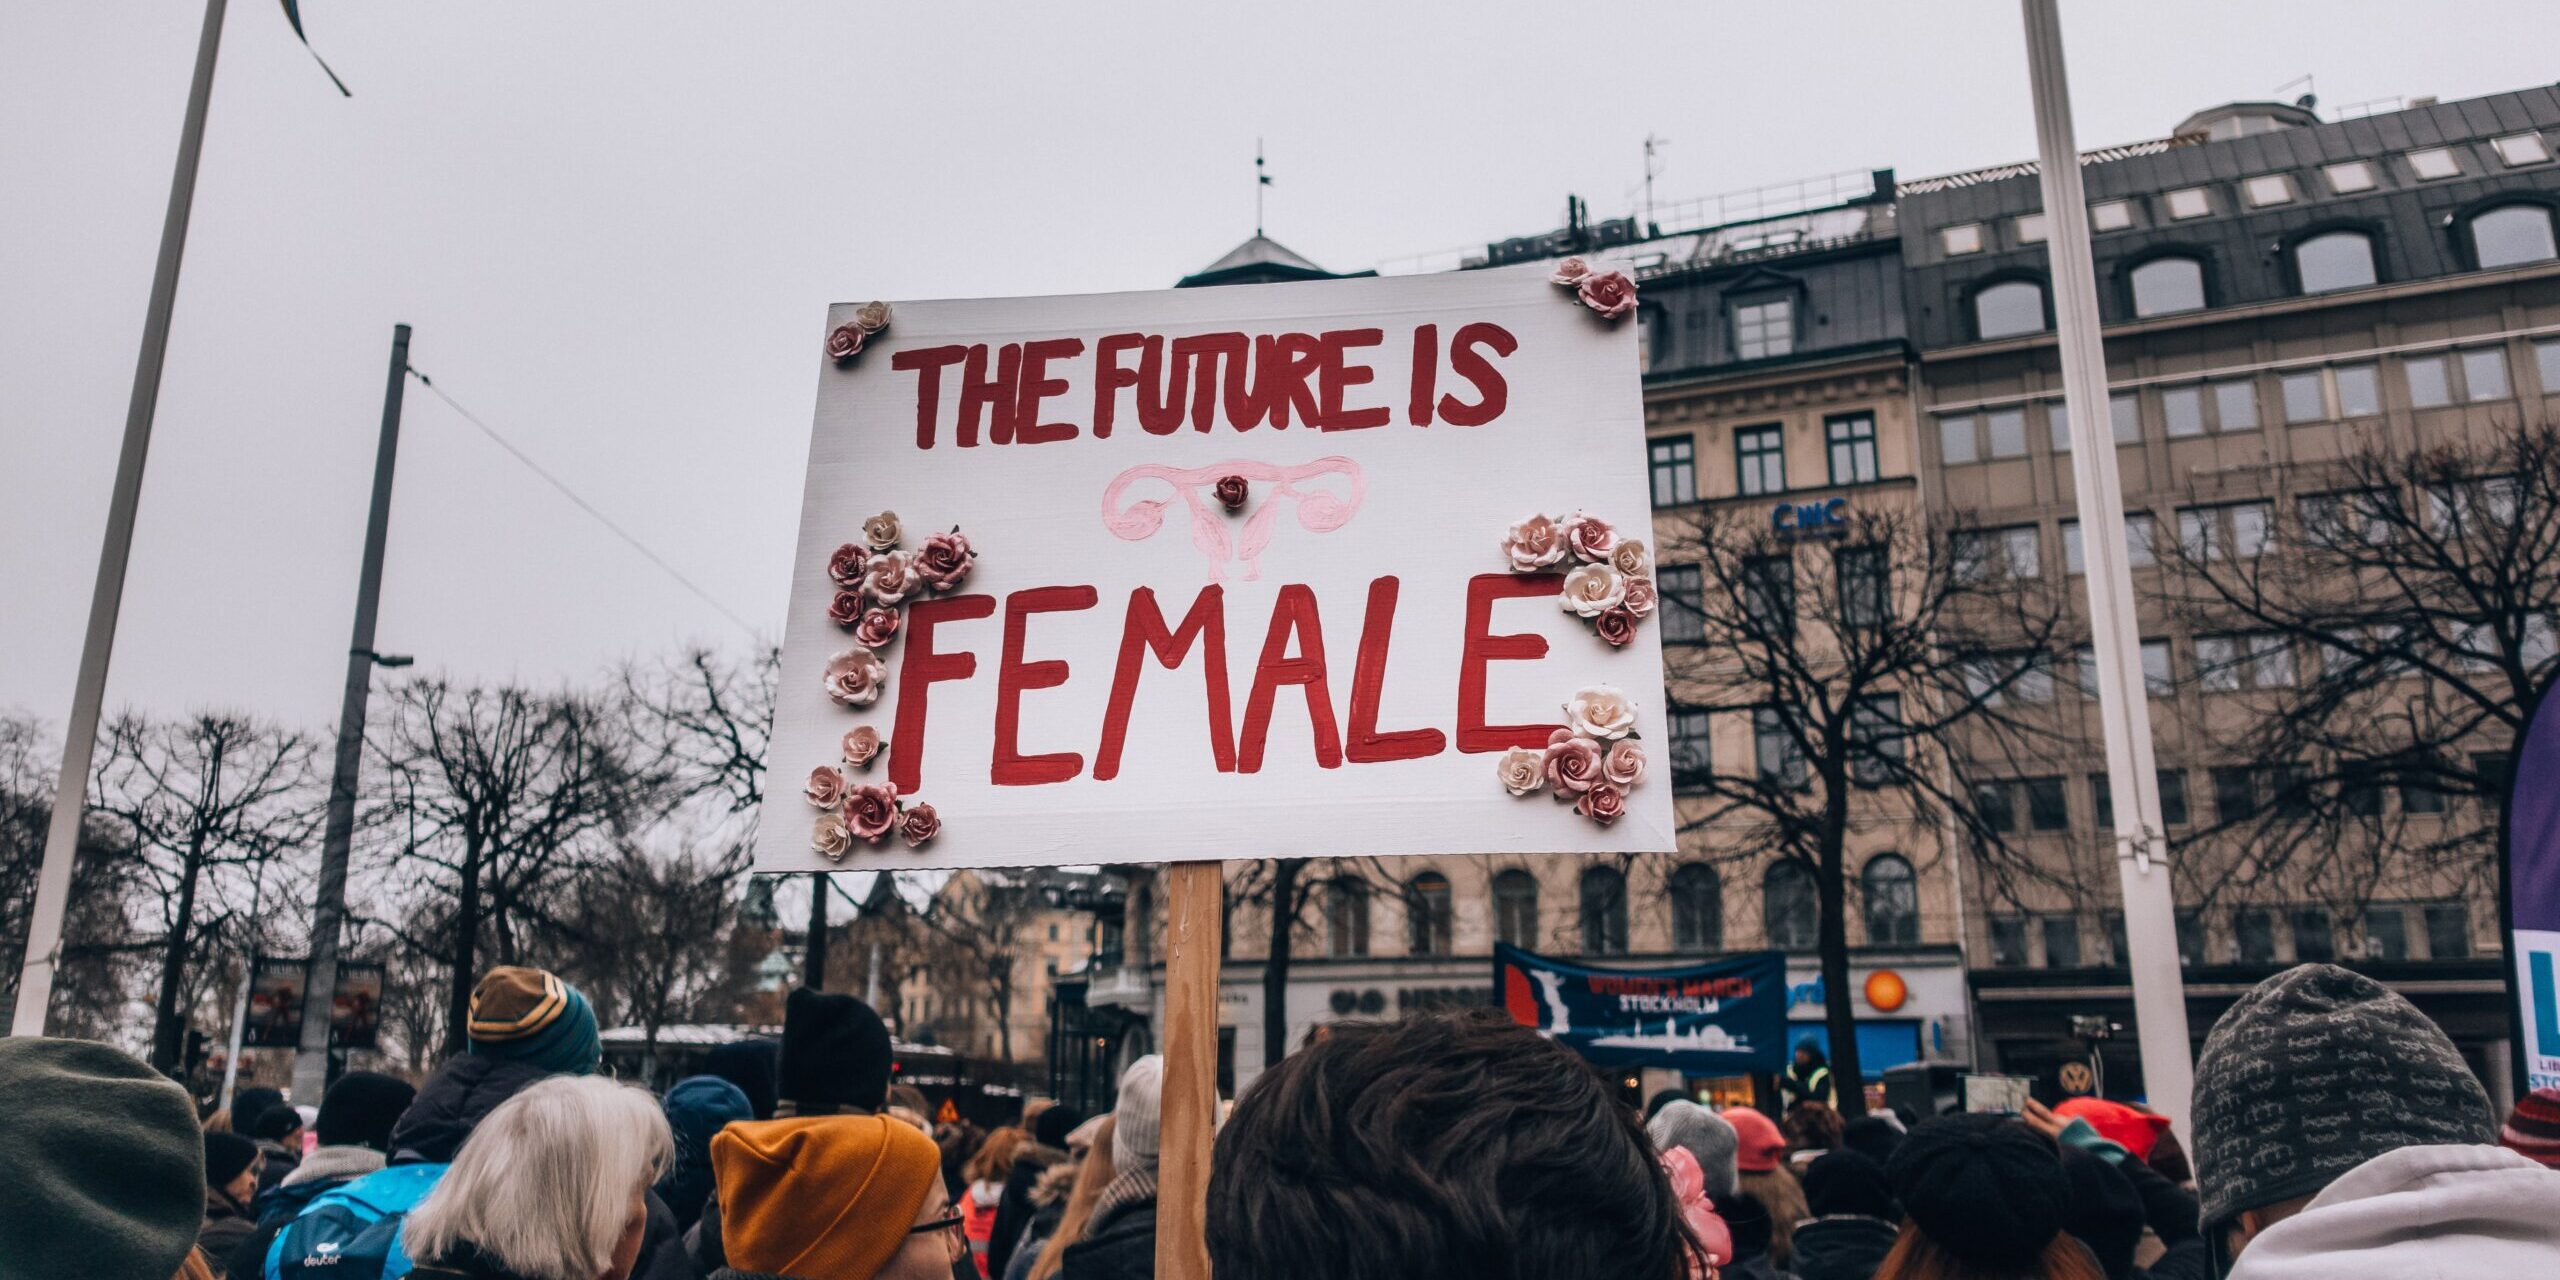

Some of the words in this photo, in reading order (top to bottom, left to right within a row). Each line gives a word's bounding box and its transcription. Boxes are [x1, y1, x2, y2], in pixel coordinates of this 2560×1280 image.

[892, 338, 1085, 449] THE
[1093, 328, 1390, 438] FUTURE
[1409, 322, 1518, 428] IS
[888, 574, 1573, 795] FEMALE
[1683, 977, 1752, 997] MARCH
[1619, 993, 1719, 1014] STOCKHOLM
[304, 1253, 341, 1267] deuter
